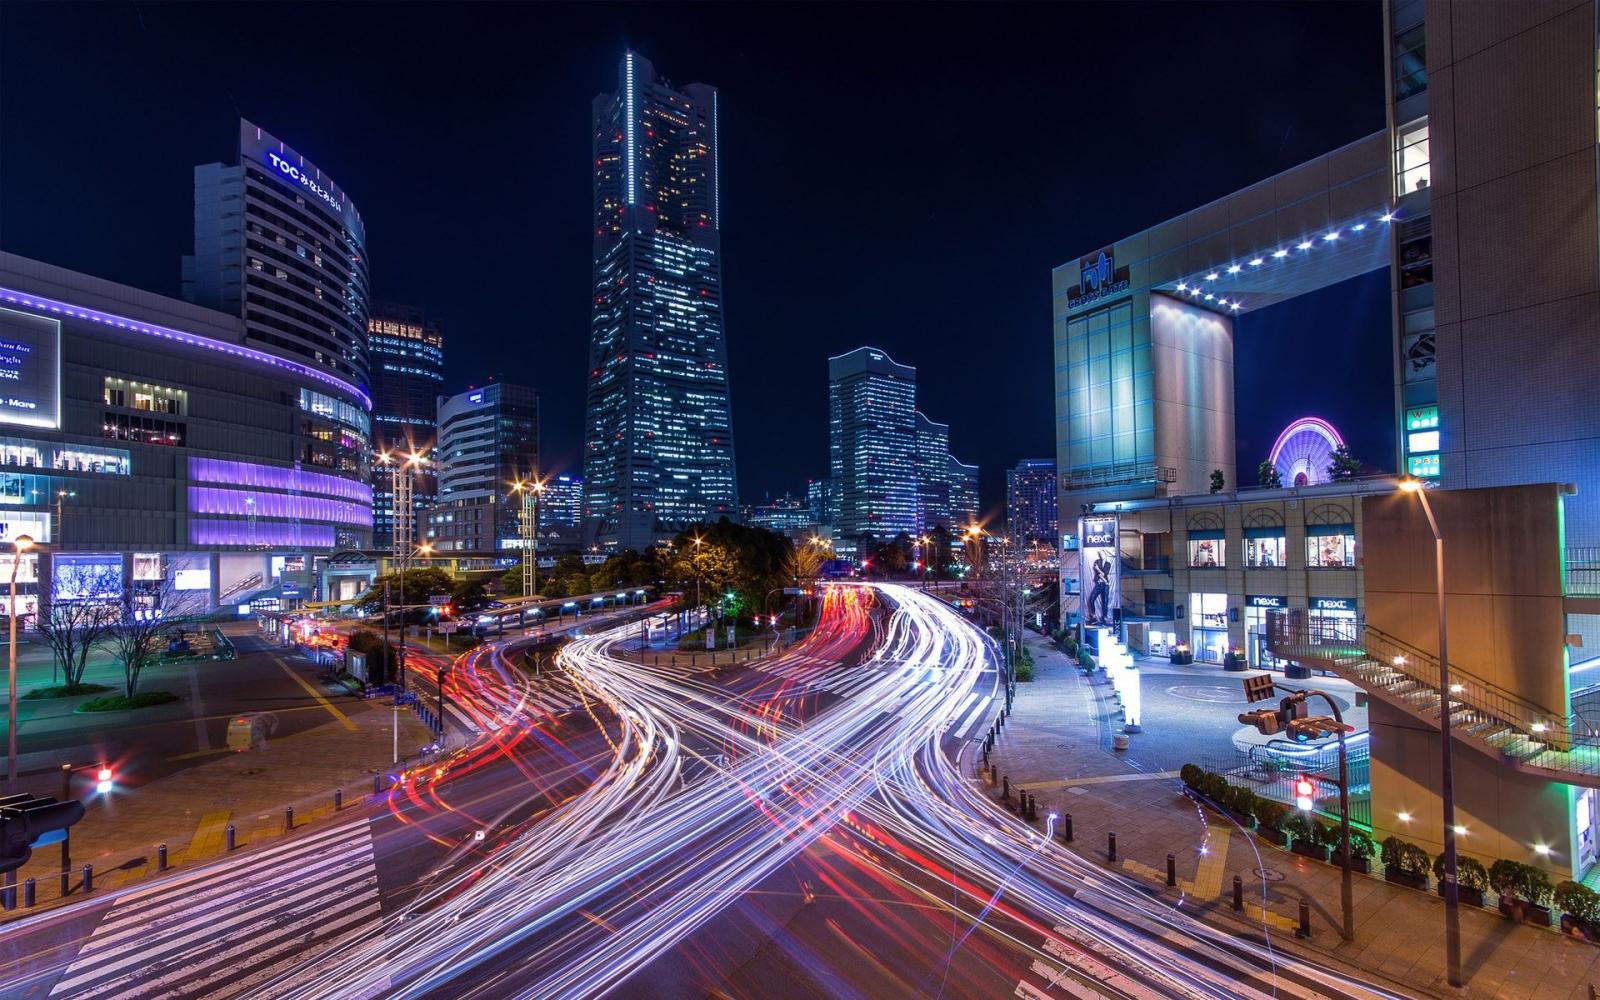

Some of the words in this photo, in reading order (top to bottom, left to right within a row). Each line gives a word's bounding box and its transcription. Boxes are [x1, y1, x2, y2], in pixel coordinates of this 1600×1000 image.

[269, 153, 299, 179] TOC
[300, 173, 342, 212] みなとみらい
[1068, 290, 1100, 309] CROSS
[1087, 535, 1111, 543] next
[1253, 597, 1280, 606] next
[1317, 599, 1347, 608] next
